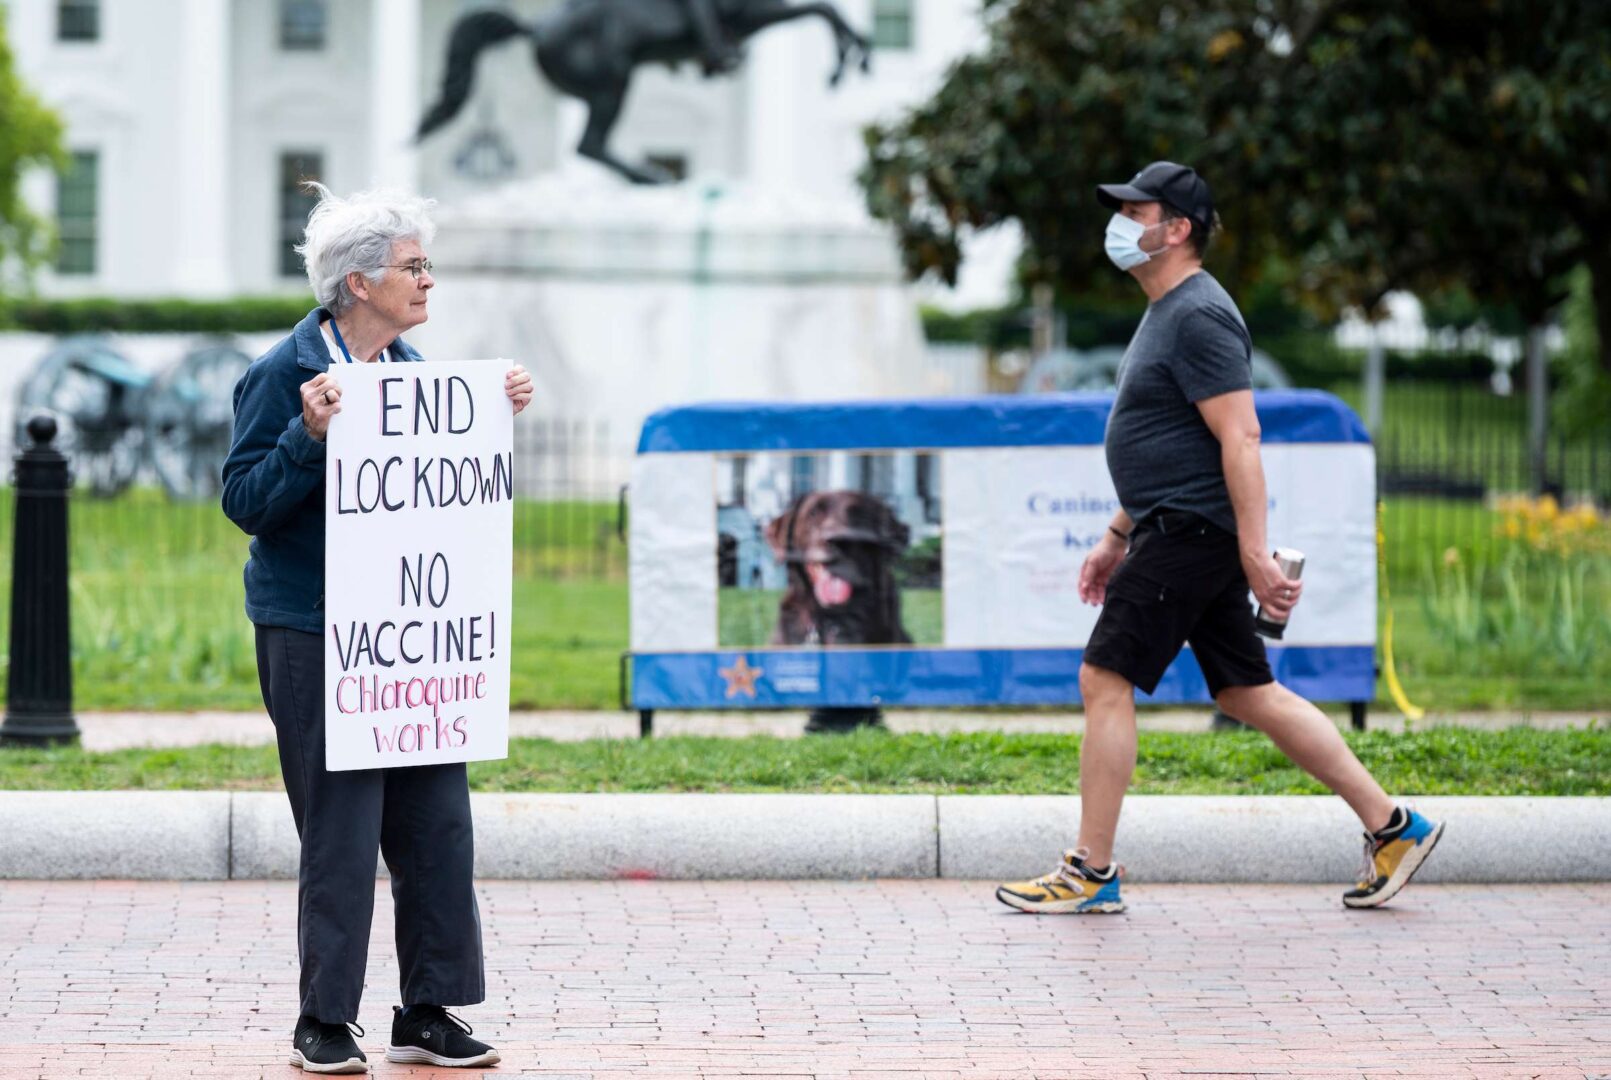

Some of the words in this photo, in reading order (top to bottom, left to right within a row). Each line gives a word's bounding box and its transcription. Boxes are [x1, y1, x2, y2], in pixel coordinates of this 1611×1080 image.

[379, 376, 474, 436] END
[336, 452, 513, 514] LOCKDOWN
[400, 552, 450, 608] NO
[332, 612, 496, 672] VACCINE!
[336, 672, 487, 717] Chloroquine
[374, 715, 467, 753] works
